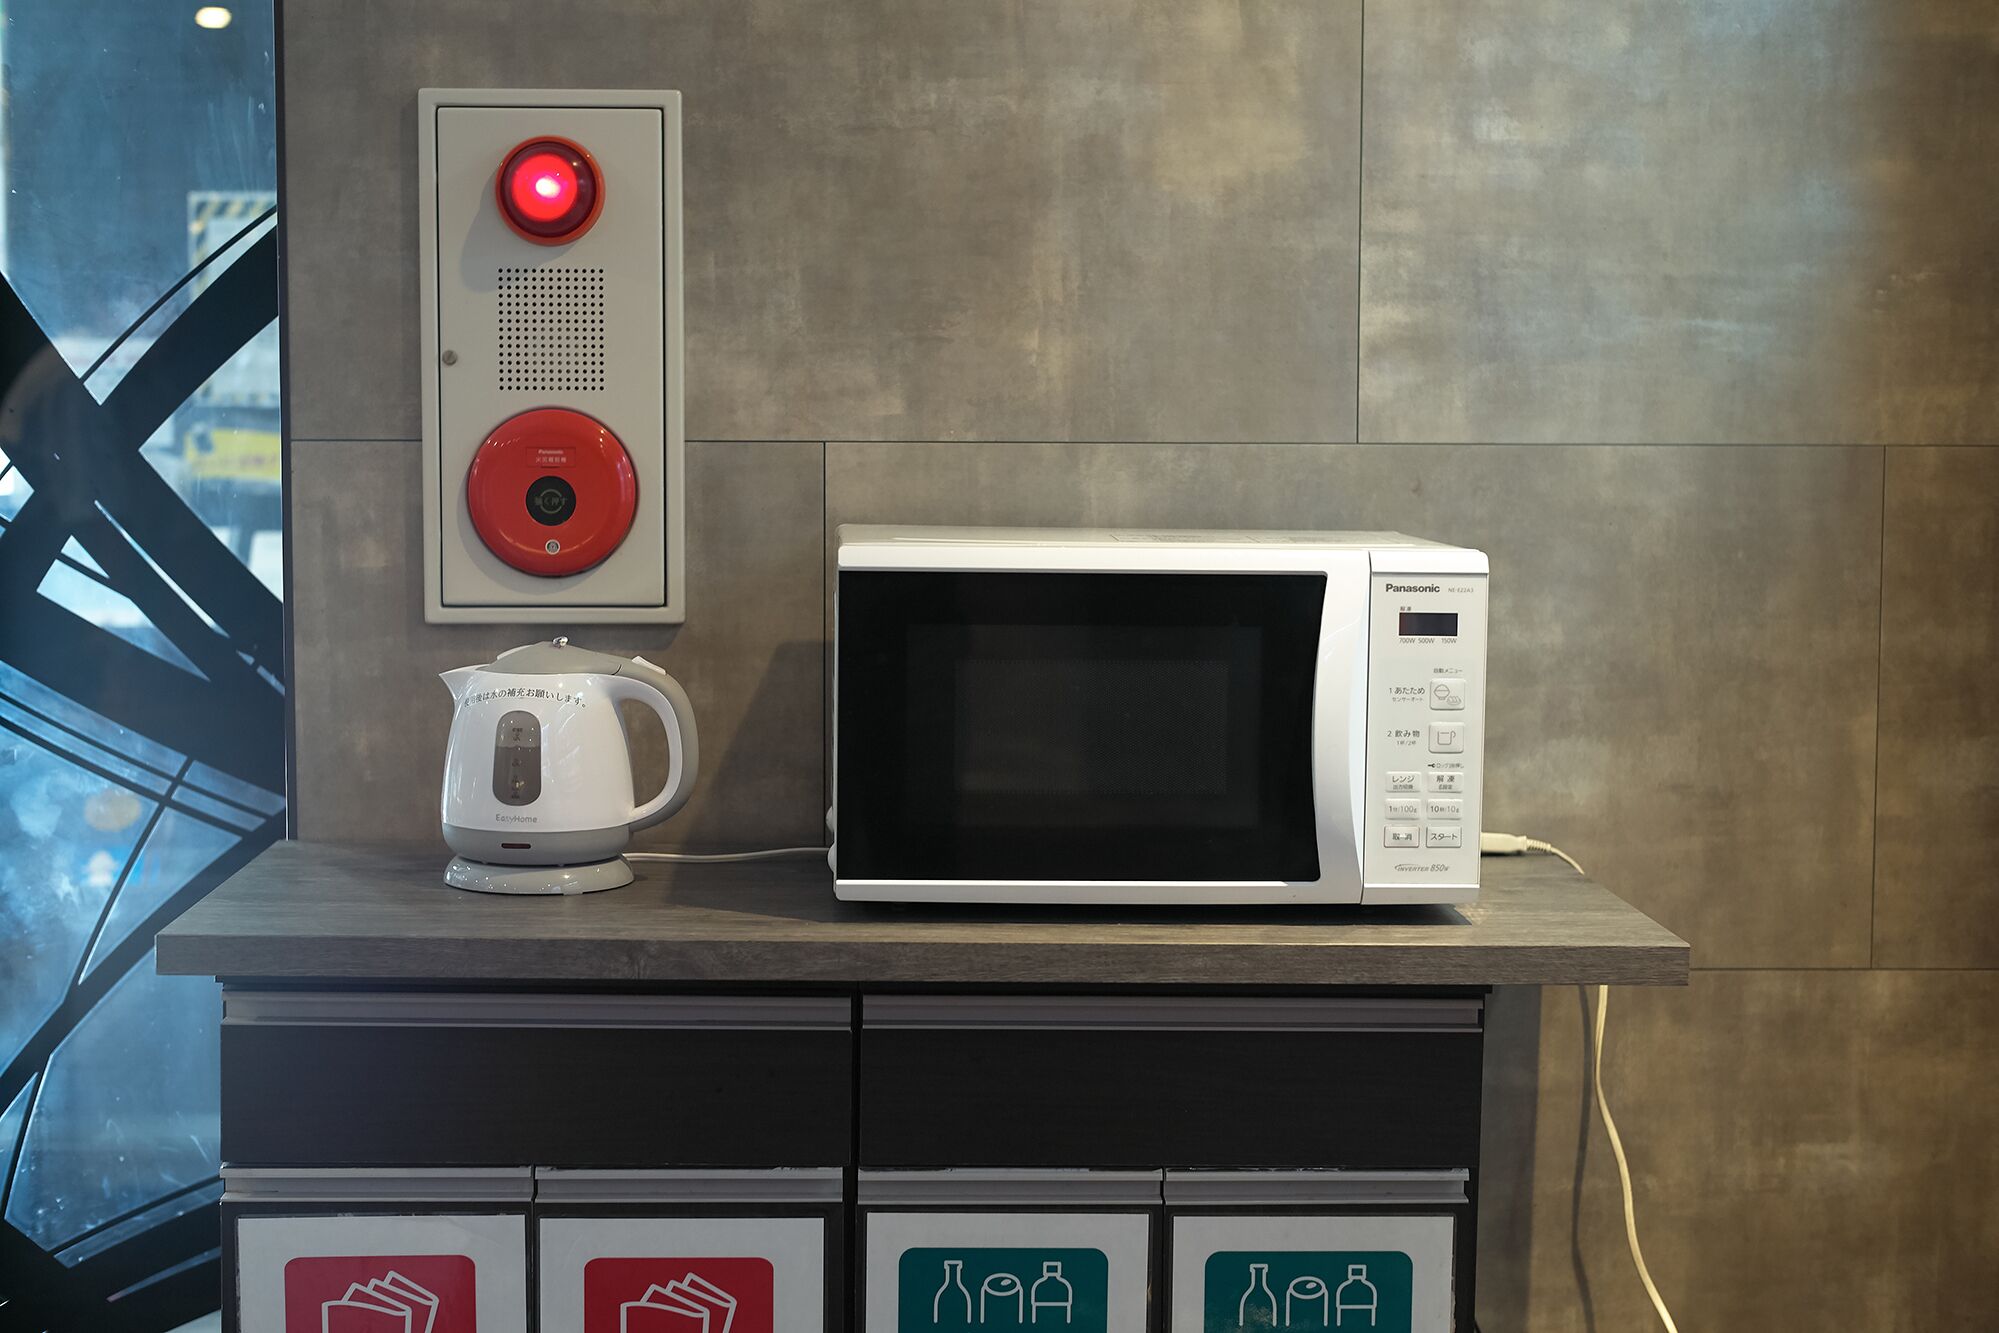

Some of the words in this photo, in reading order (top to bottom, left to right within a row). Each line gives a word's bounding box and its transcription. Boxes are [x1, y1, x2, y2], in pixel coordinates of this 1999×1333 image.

[1385, 583, 1441, 593] Panasonic
[1394, 687, 1425, 695] あたため
[1392, 775, 1415, 783] レンジ
[495, 813, 538, 824] EasyHome
[1430, 833, 1458, 841] スタート
